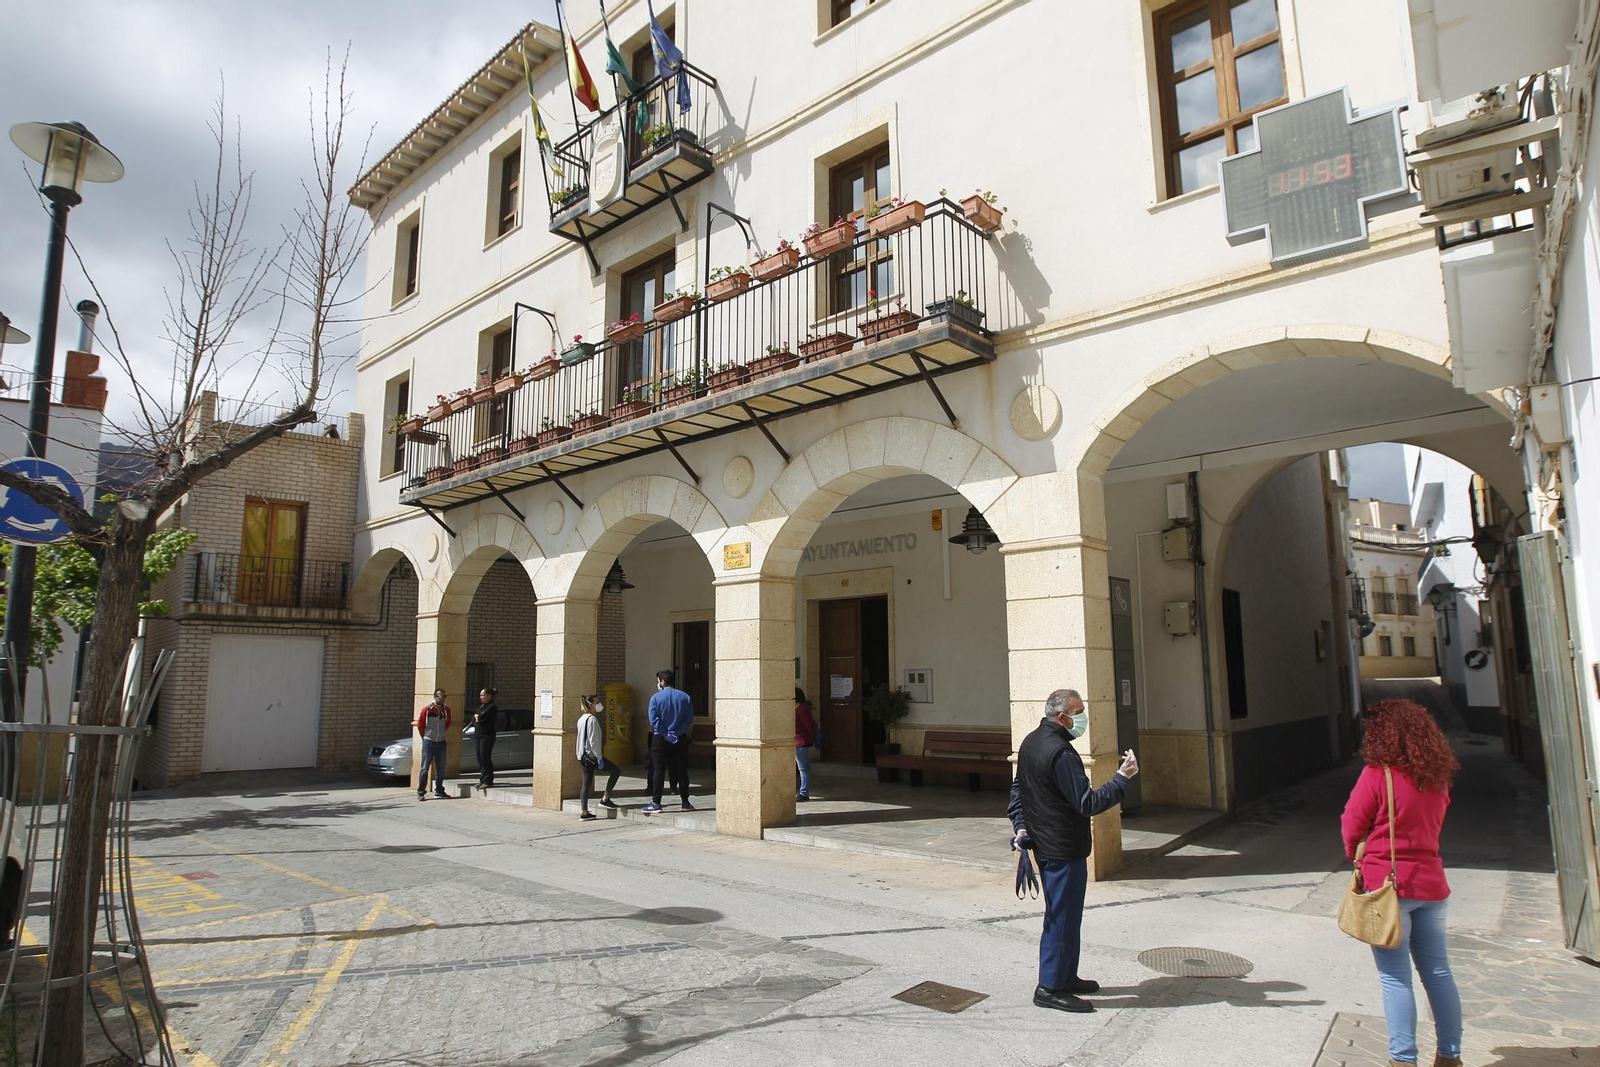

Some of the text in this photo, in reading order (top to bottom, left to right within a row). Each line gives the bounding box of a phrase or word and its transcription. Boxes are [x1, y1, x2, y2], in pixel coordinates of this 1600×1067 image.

[1278, 153, 1352, 193] 11:53
[801, 532, 918, 562] AYUNTAMIENTO
[608, 698, 616, 741] CORREOS
